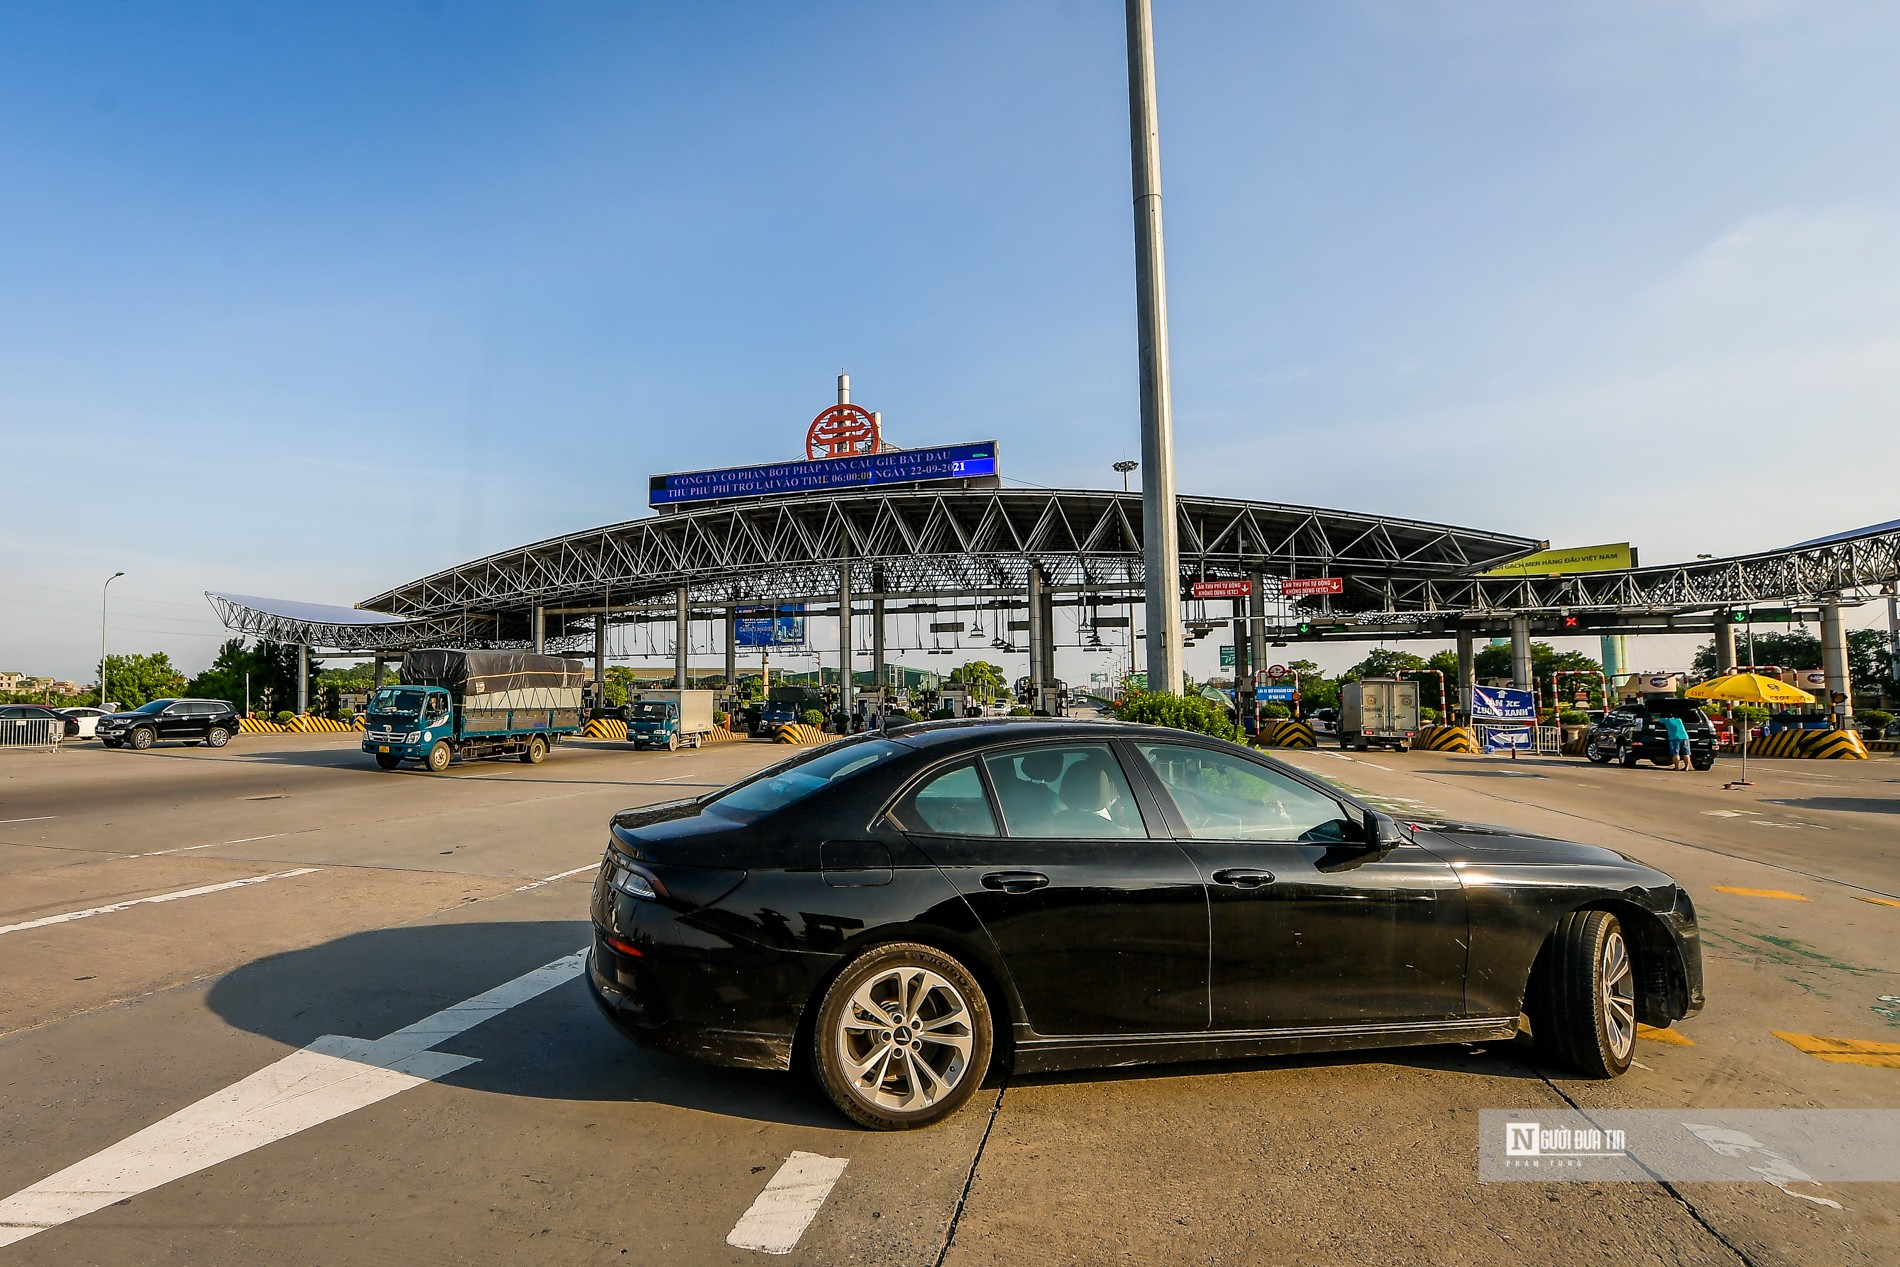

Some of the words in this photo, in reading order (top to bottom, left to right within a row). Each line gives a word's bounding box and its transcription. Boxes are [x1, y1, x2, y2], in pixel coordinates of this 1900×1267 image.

[668, 488, 688, 498] THU
[713, 483, 730, 494] PHÍ
[756, 480, 774, 491] LẠI
[801, 474, 830, 485] TIME
[874, 466, 908, 478] NGÀY
[910, 461, 966, 475] 22-09-2021
[705, 474, 719, 483] TY
[769, 467, 791, 478] BOT
